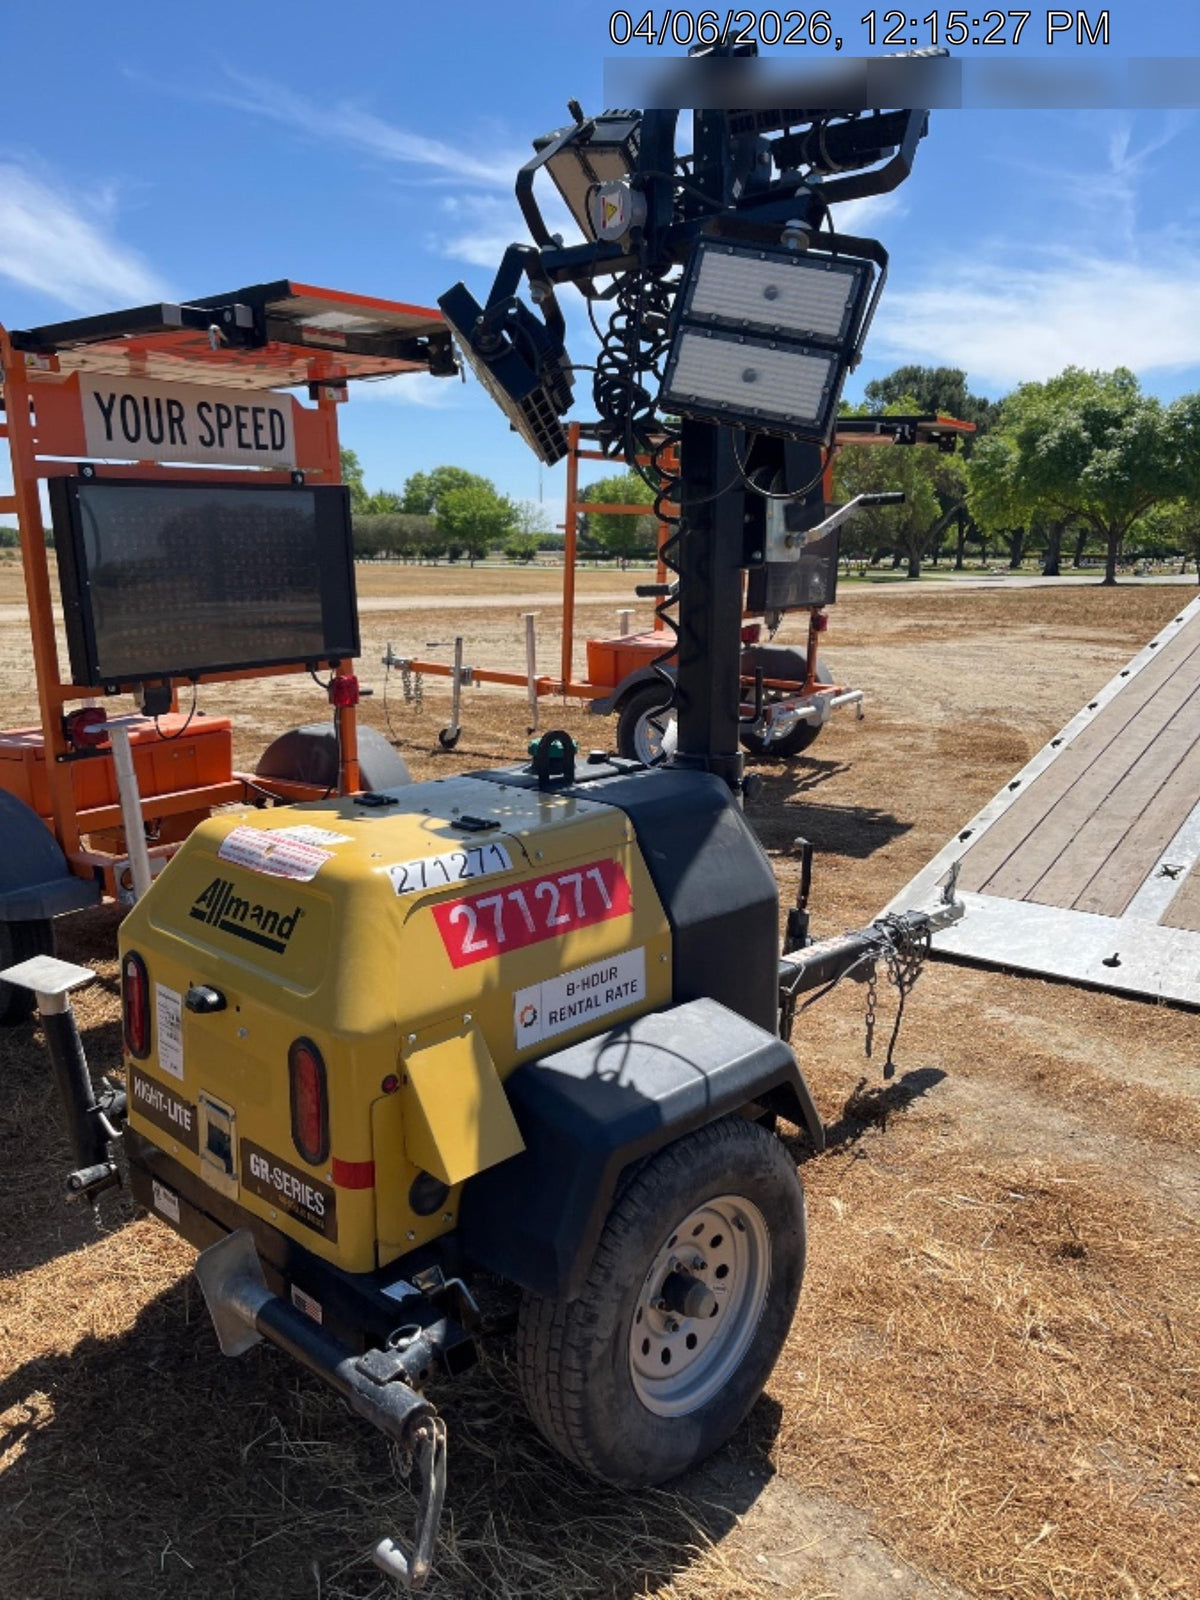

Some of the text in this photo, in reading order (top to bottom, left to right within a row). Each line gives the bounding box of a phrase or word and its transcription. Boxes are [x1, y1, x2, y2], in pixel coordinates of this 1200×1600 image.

[93, 391, 285, 450] YOUR SPEED
[390, 843, 506, 894] 271271
[194, 878, 302, 940] Allmand
[449, 867, 612, 954] 271271
[549, 979, 638, 1025] RENTAL RATE
[566, 966, 618, 996] 8-HOUR
[134, 1076, 191, 1131] NIGHT-LITE
[250, 1153, 325, 1216] GR-SERIES
